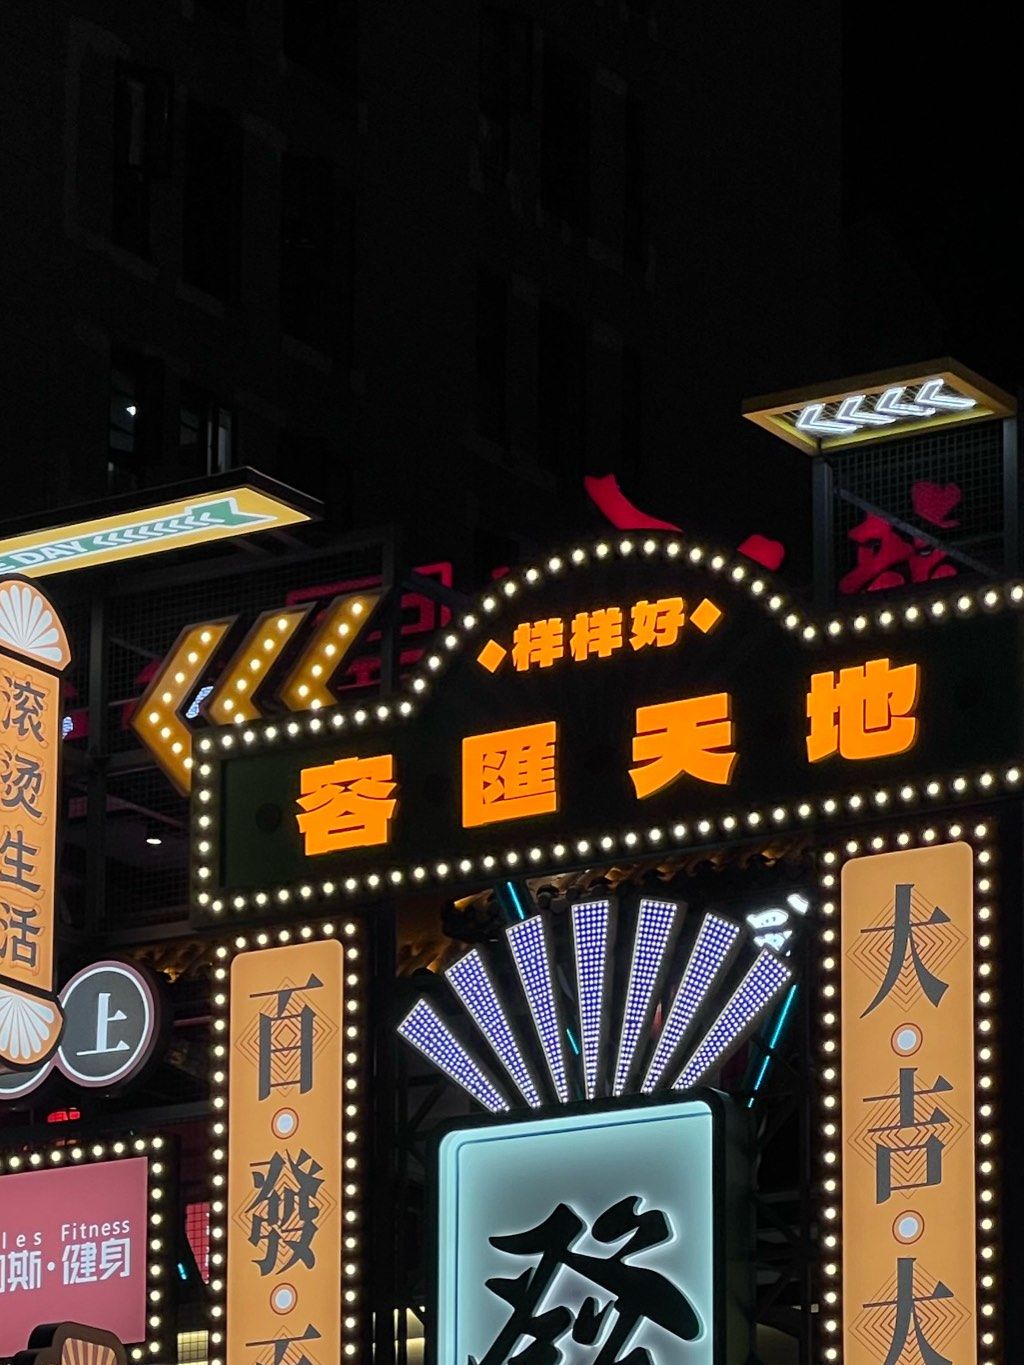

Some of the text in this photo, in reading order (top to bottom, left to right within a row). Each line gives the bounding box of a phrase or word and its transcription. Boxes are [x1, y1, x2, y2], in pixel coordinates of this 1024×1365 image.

[9, 540, 88, 565] DAY
[512, 597, 686, 673] 样样好
[295, 657, 920, 857] 容匯天地
[61, 1218, 131, 1243] Fitness
